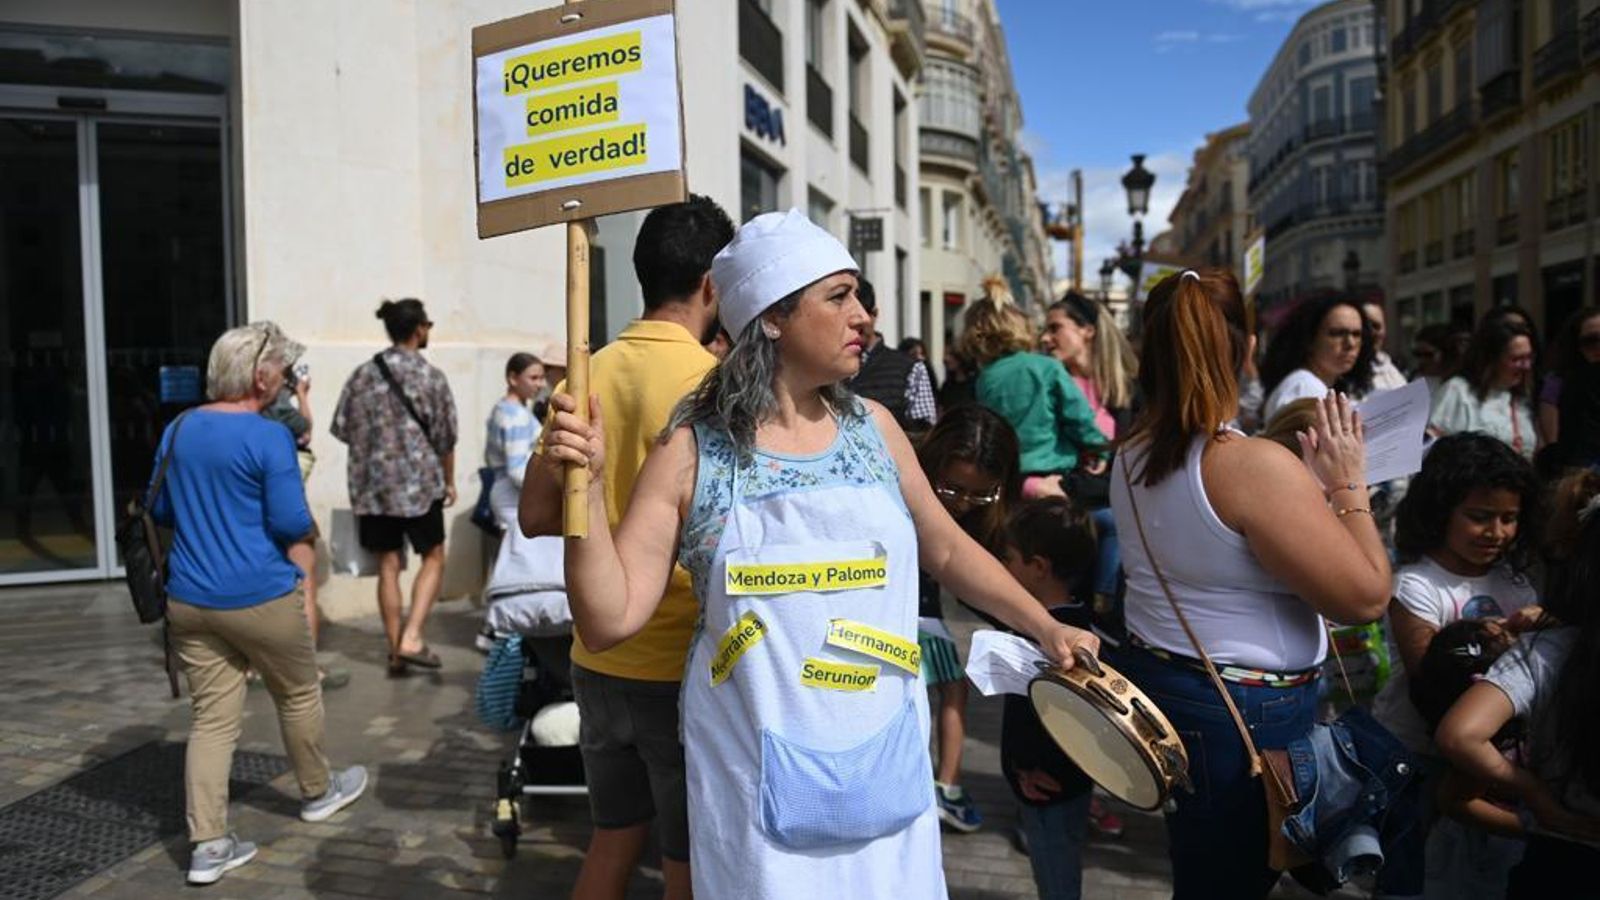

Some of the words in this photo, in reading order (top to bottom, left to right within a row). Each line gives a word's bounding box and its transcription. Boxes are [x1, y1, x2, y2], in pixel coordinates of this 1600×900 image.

[504, 45, 641, 92] ¡Queremos
[527, 93, 618, 126] comida
[506, 155, 534, 177] de
[549, 132, 646, 168] verdad!
[728, 571, 806, 586] Mendoza
[812, 573, 821, 587] y
[827, 566, 886, 582] Palomo
[829, 623, 908, 660] Hermanos
[802, 664, 876, 686] Serunion
